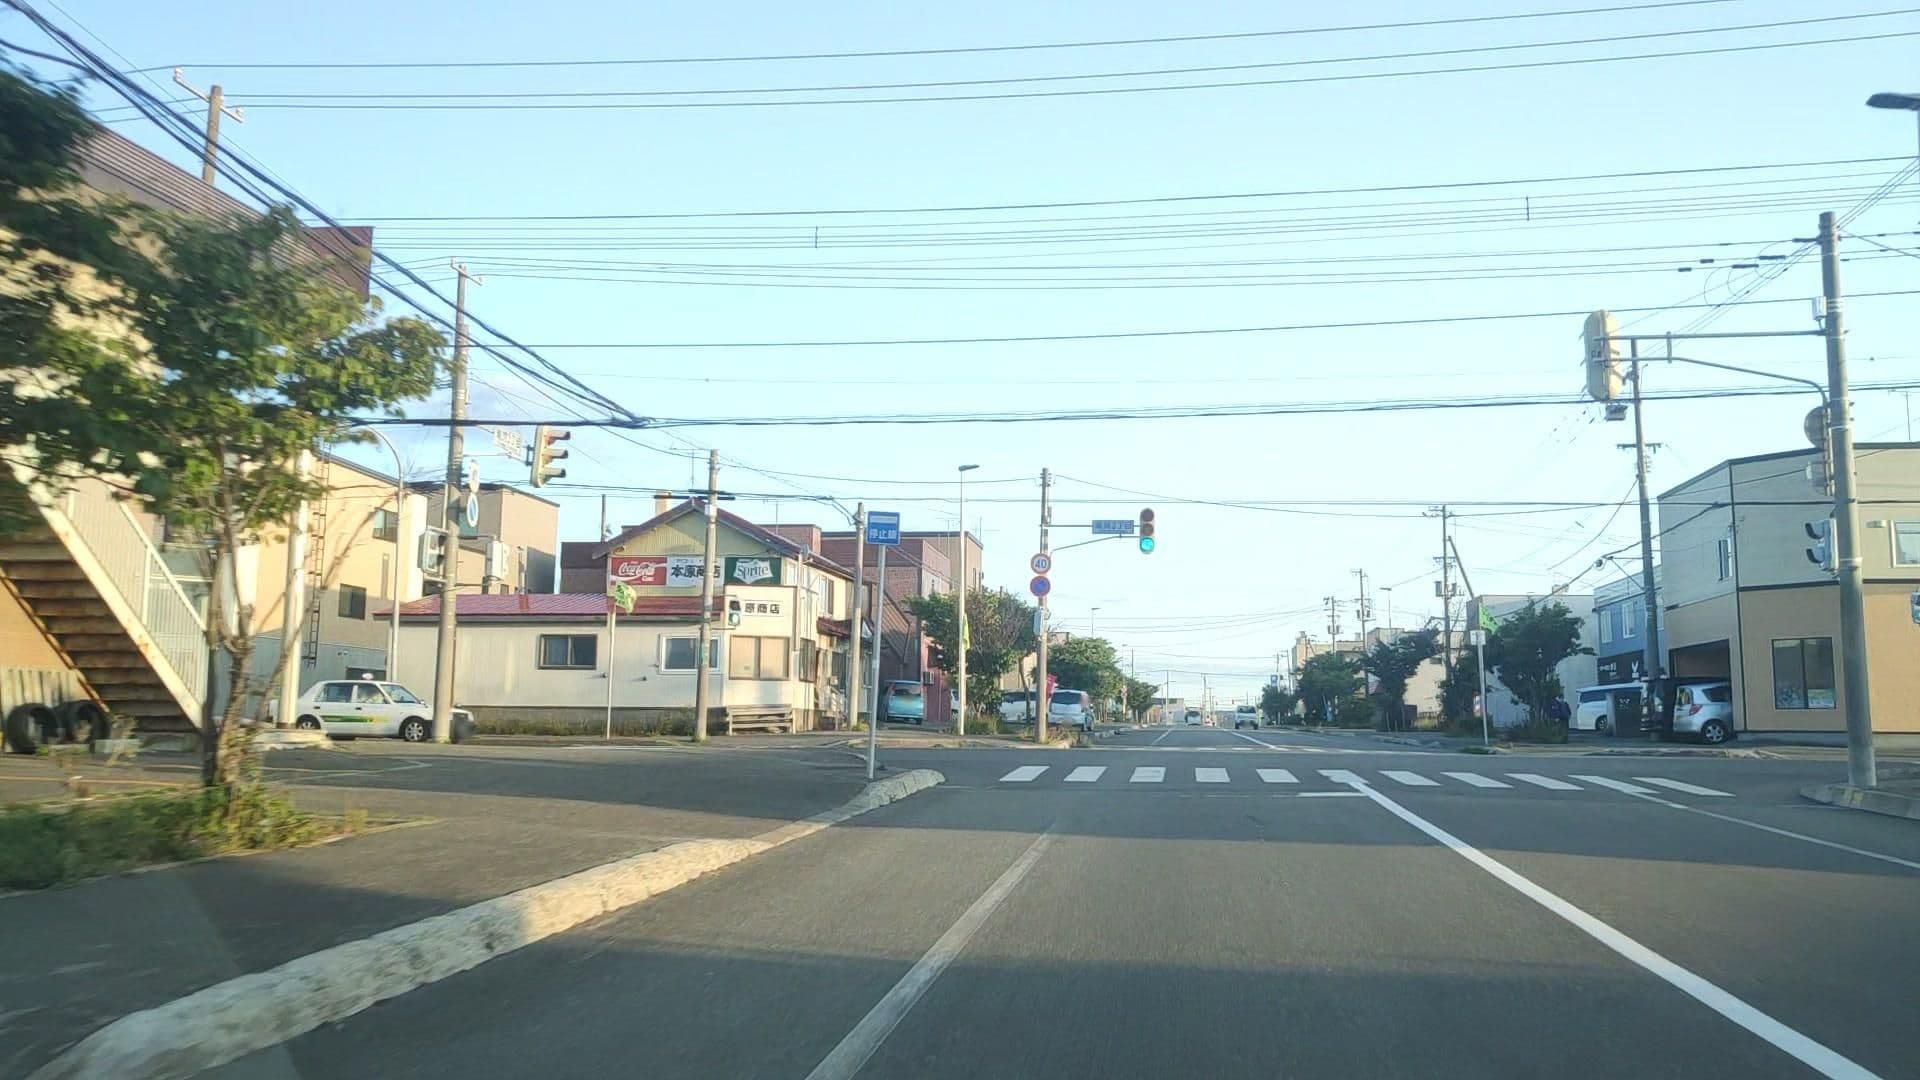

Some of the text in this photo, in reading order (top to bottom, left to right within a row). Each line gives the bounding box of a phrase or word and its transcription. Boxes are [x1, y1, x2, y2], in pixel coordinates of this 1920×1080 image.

[1035, 559, 1047, 569] 40
[737, 565, 769, 579] Sprite
[744, 602, 780, 614] 原商店
